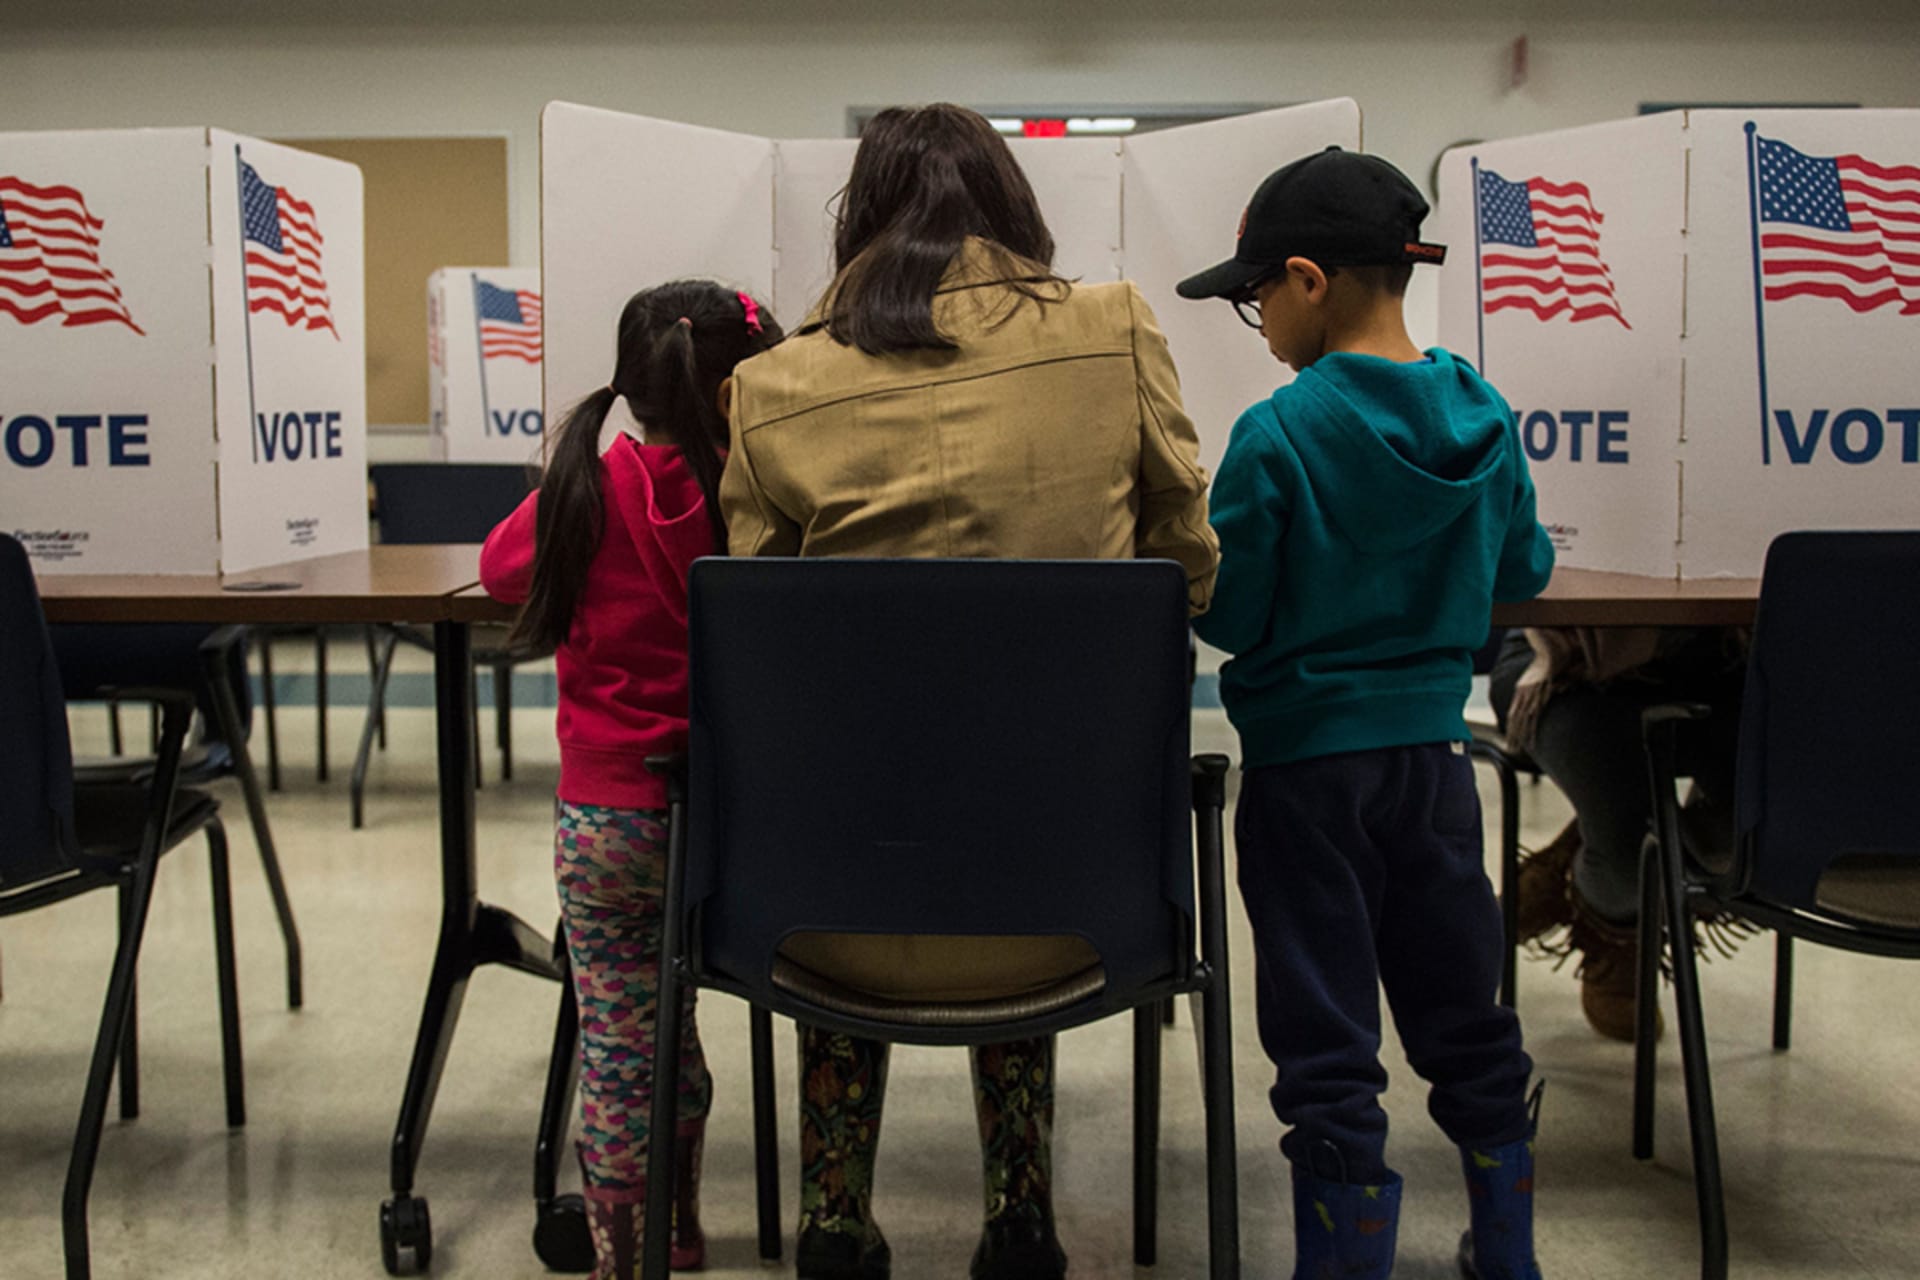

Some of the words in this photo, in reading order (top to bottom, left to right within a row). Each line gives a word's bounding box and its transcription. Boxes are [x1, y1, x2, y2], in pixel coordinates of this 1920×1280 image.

[0, 414, 151, 468] OTE
[257, 411, 342, 463] VOTE
[1514, 410, 1630, 464] OTE
